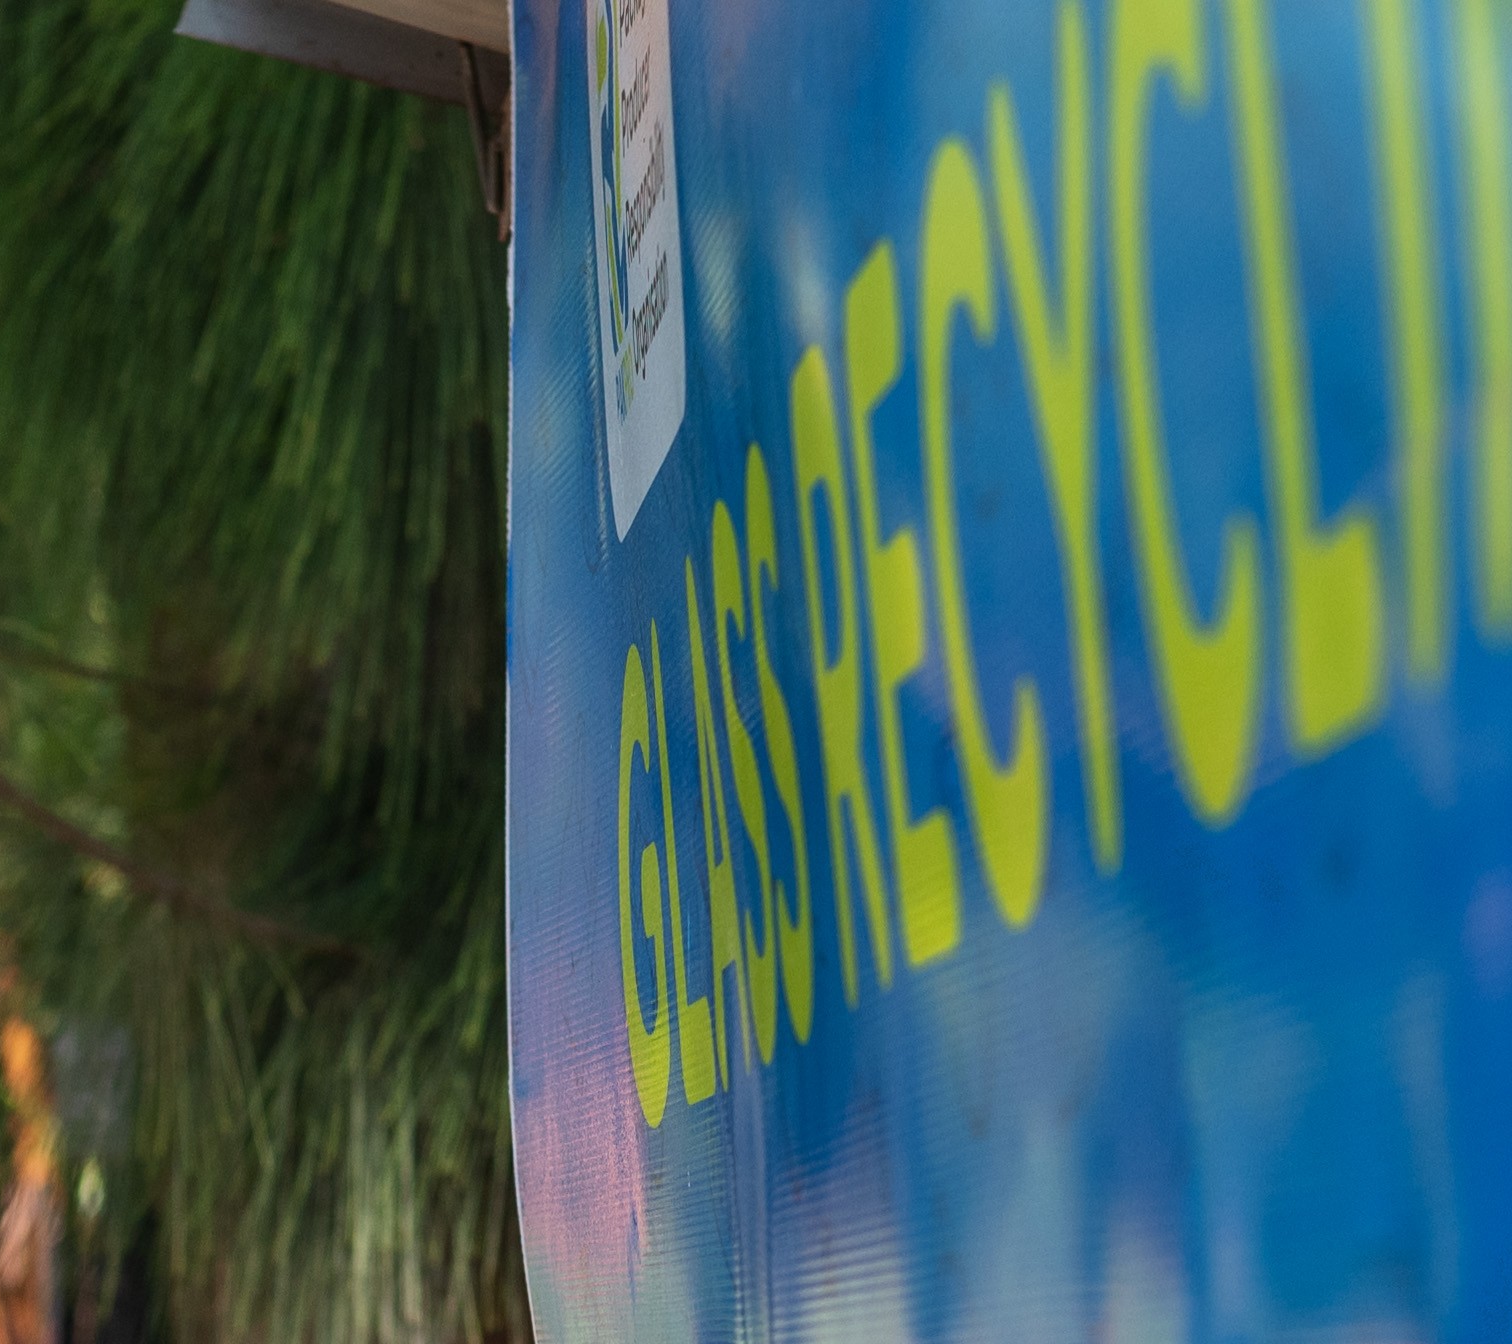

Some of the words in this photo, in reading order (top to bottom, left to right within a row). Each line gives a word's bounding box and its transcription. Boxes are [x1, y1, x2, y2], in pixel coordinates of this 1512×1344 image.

[620, 43, 651, 158] Producer
[625, 113, 666, 270] Responsibility
[617, 440, 813, 1129] GLASS
